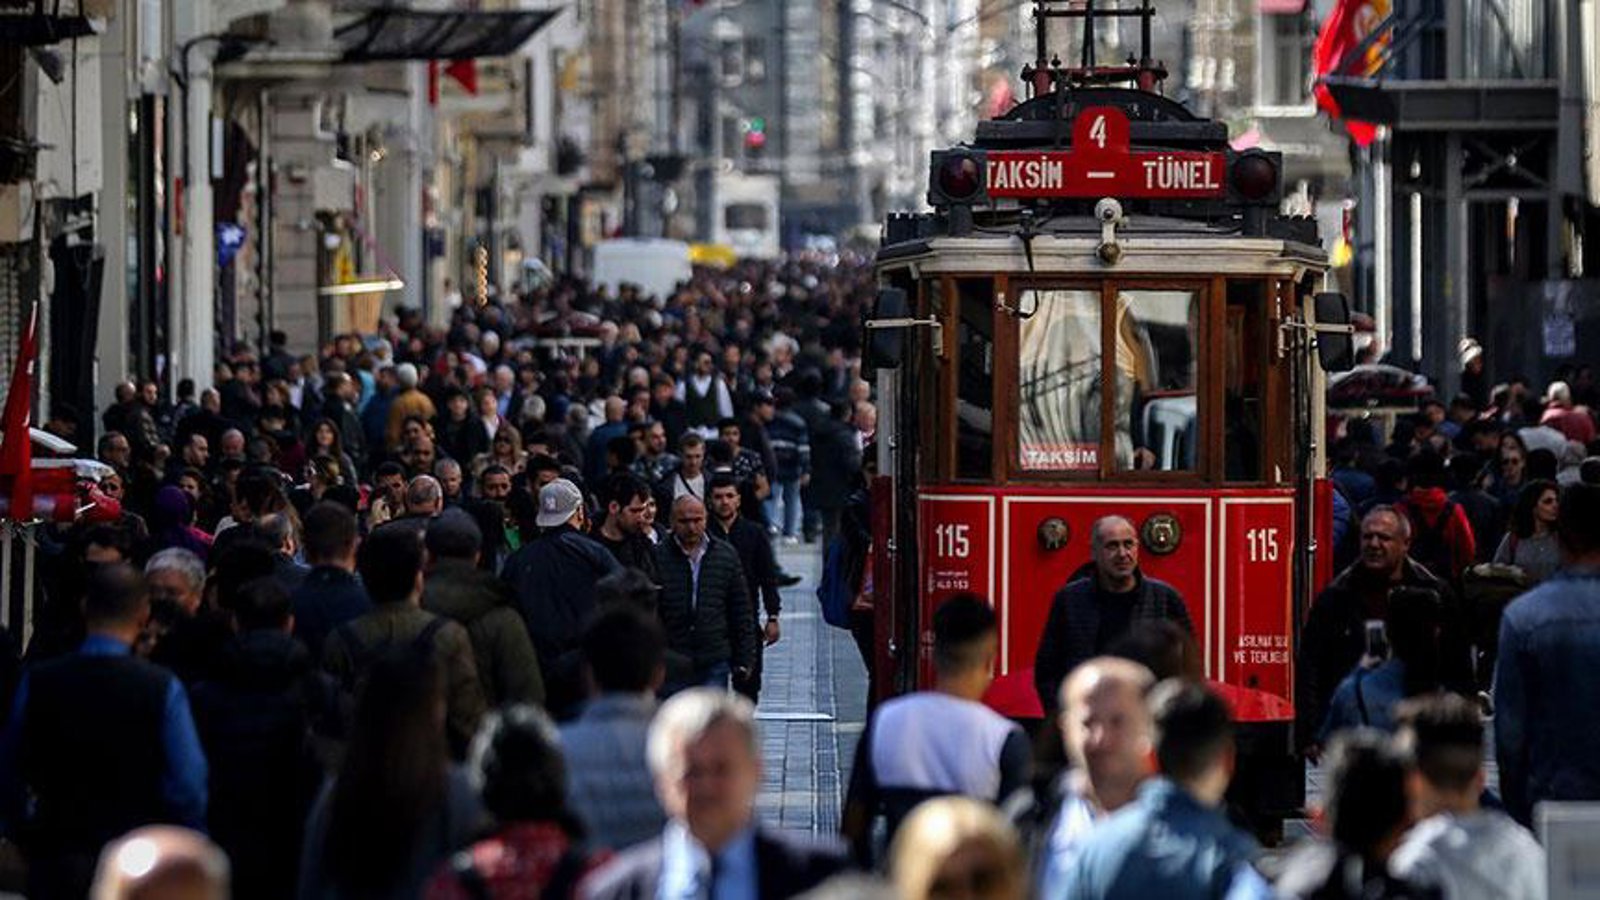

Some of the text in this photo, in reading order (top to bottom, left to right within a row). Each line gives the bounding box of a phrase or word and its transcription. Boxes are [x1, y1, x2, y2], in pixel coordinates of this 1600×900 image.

[1089, 115, 1106, 148] 4
[986, 155, 1063, 189] TAKSİM
[1142, 155, 1220, 189] TÜNEL
[1027, 447, 1097, 464] TAKSİM
[935, 523, 970, 558] 115
[1246, 528, 1279, 562] 115
